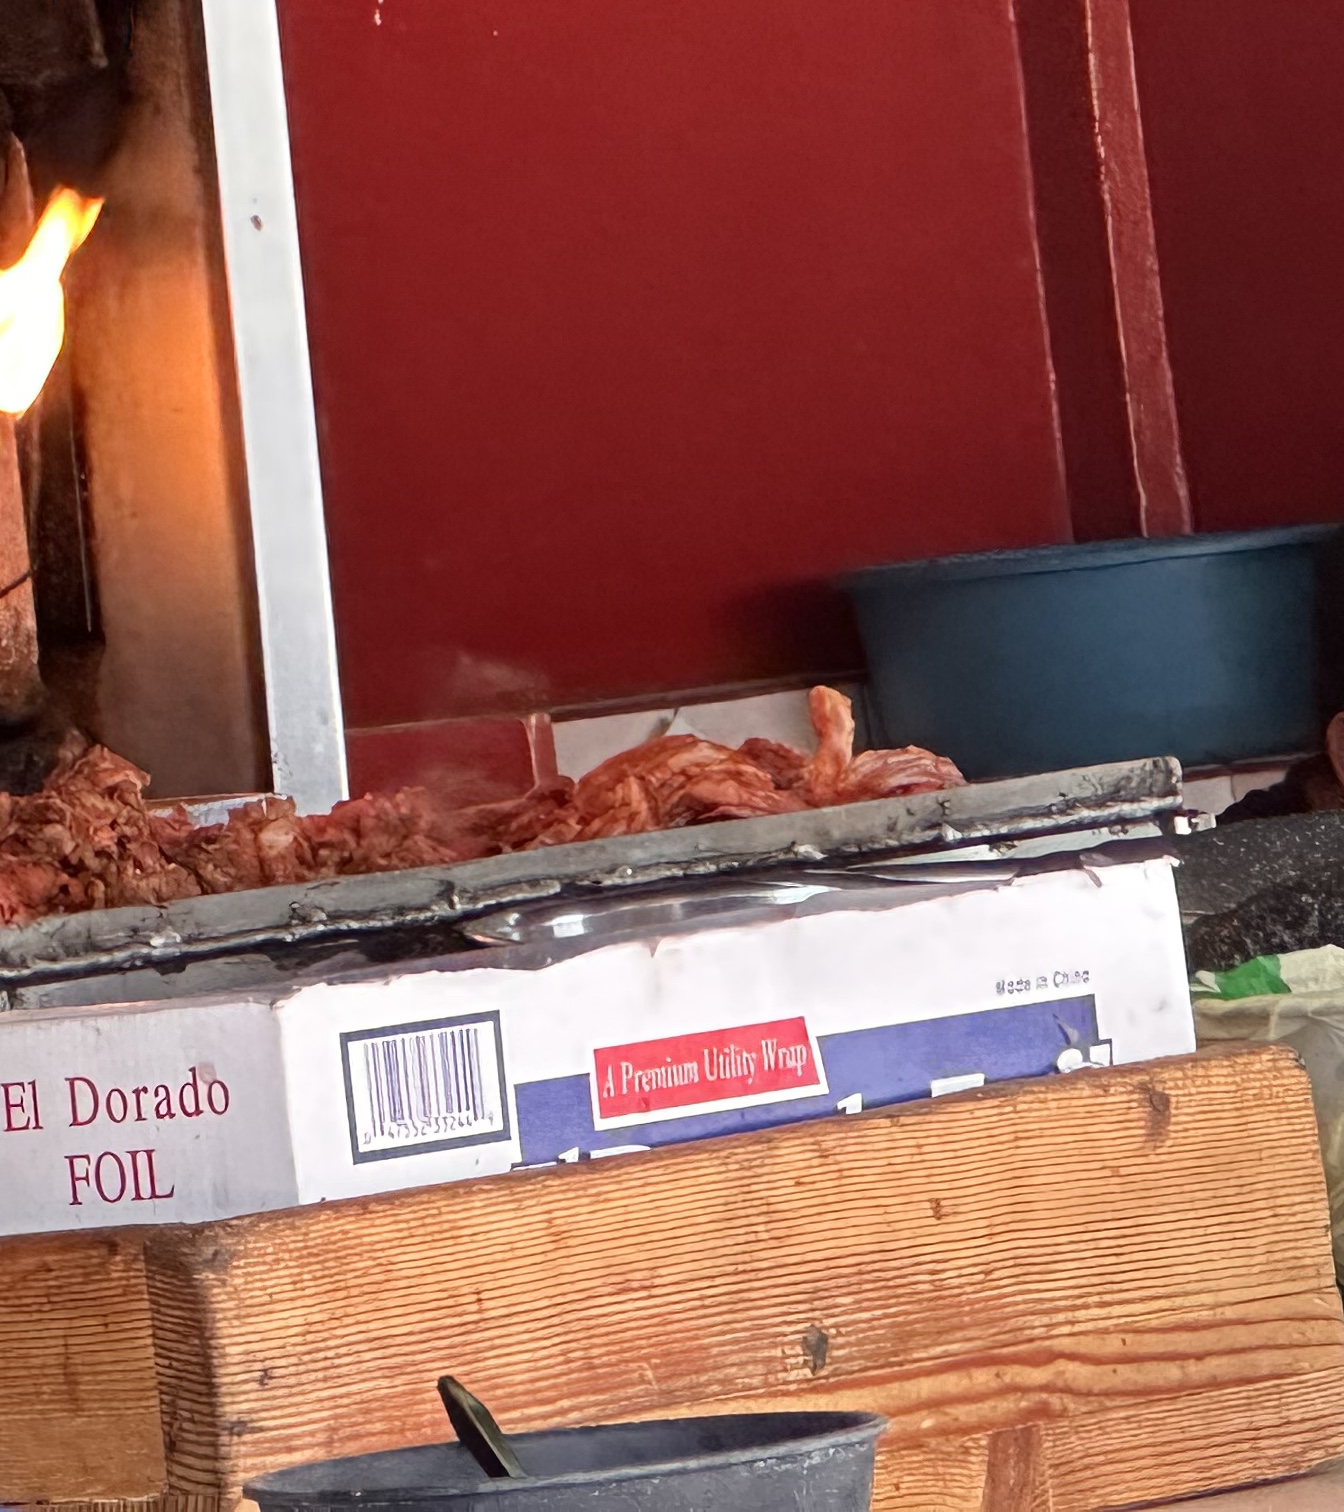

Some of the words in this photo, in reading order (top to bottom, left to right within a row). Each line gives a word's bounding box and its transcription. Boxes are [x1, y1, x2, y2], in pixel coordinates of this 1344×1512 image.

[0, 1079, 44, 1132] El
[64, 1066, 230, 1128] Dorado
[602, 1065, 615, 1099] A
[621, 1057, 700, 1094] Premium
[703, 1044, 757, 1085] Utility
[761, 1038, 807, 1077] Wrap
[64, 1149, 175, 1206] FOIL
